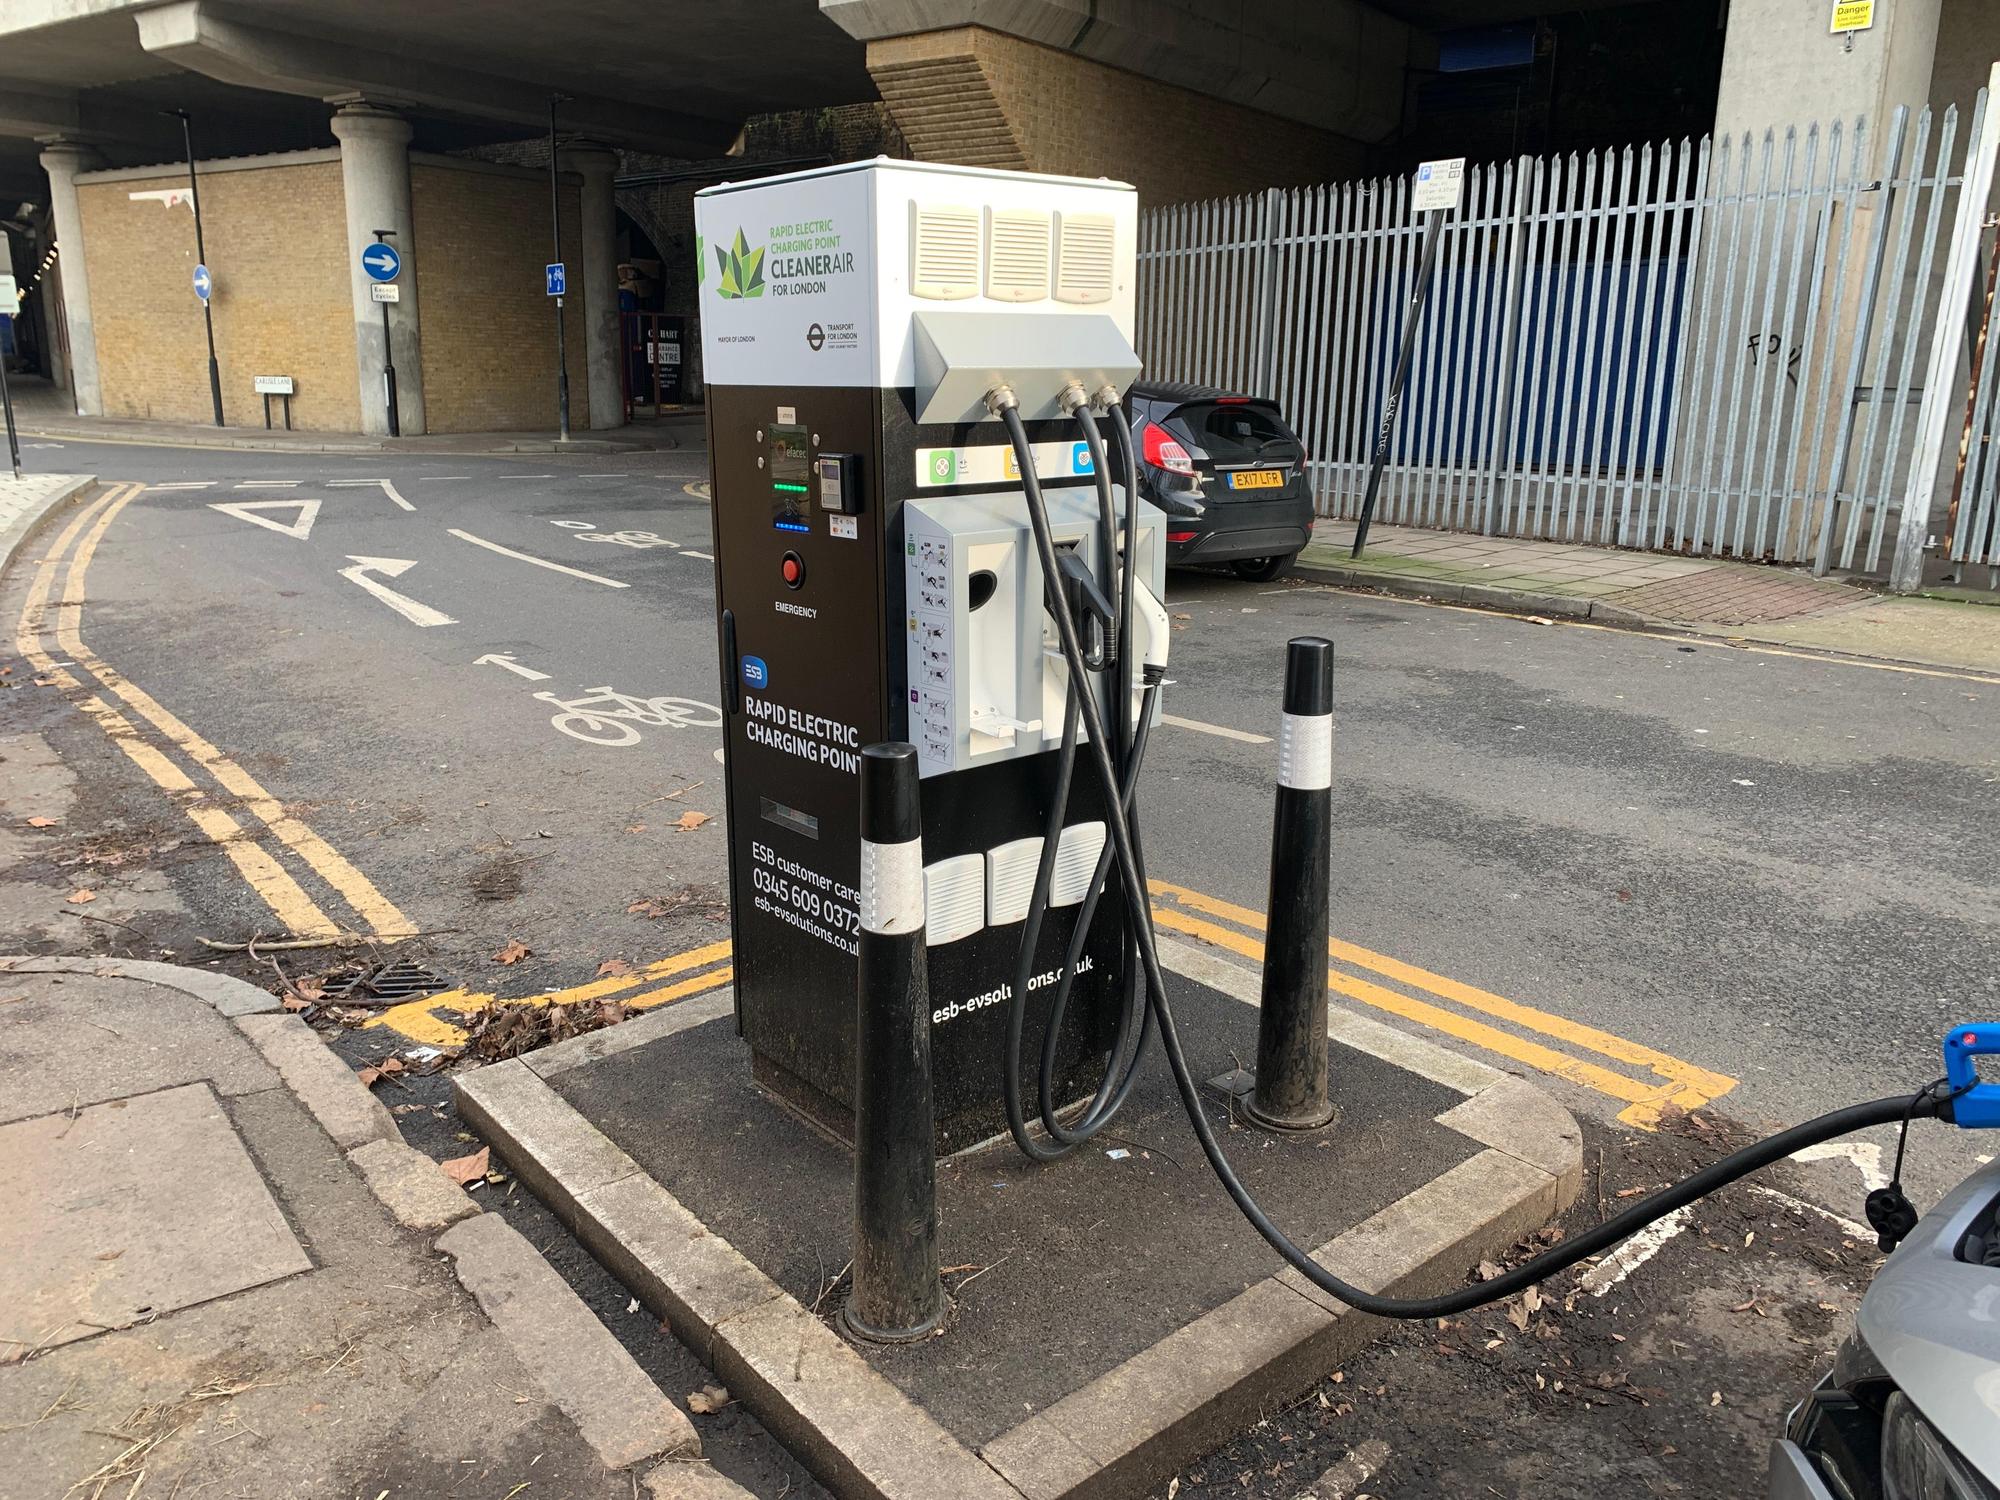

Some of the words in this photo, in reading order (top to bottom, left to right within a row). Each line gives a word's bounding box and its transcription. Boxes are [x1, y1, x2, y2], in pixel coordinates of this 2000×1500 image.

[1837, 6, 1869, 15] Danger
[770, 225, 793, 238] RAPID
[795, 220, 833, 235] ELECTRIC
[771, 239, 812, 254] CHARGING
[815, 236, 840, 249] POINT
[773, 284, 788, 296] FOR
[790, 281, 826, 295] LONDON
[827, 323, 854, 331] TRANSPORT
[837, 332, 858, 340] LONDON
[649, 353, 680, 362] CNTRE
[786, 446, 806, 459] efacec
[1236, 473, 1257, 486] EX17
[1260, 472, 1279, 485] LFR
[775, 601, 817, 619] EMERGENCY
[745, 695, 786, 725] RAPID
[789, 708, 859, 748] ELECTRIC
[746, 721, 818, 762] CHARGING
[752, 841, 775, 866] ESB
[777, 857, 833, 891] customer
[753, 867, 789, 902] 0345
[791, 885, 820, 917] 609
[823, 900, 860, 937] 0372
